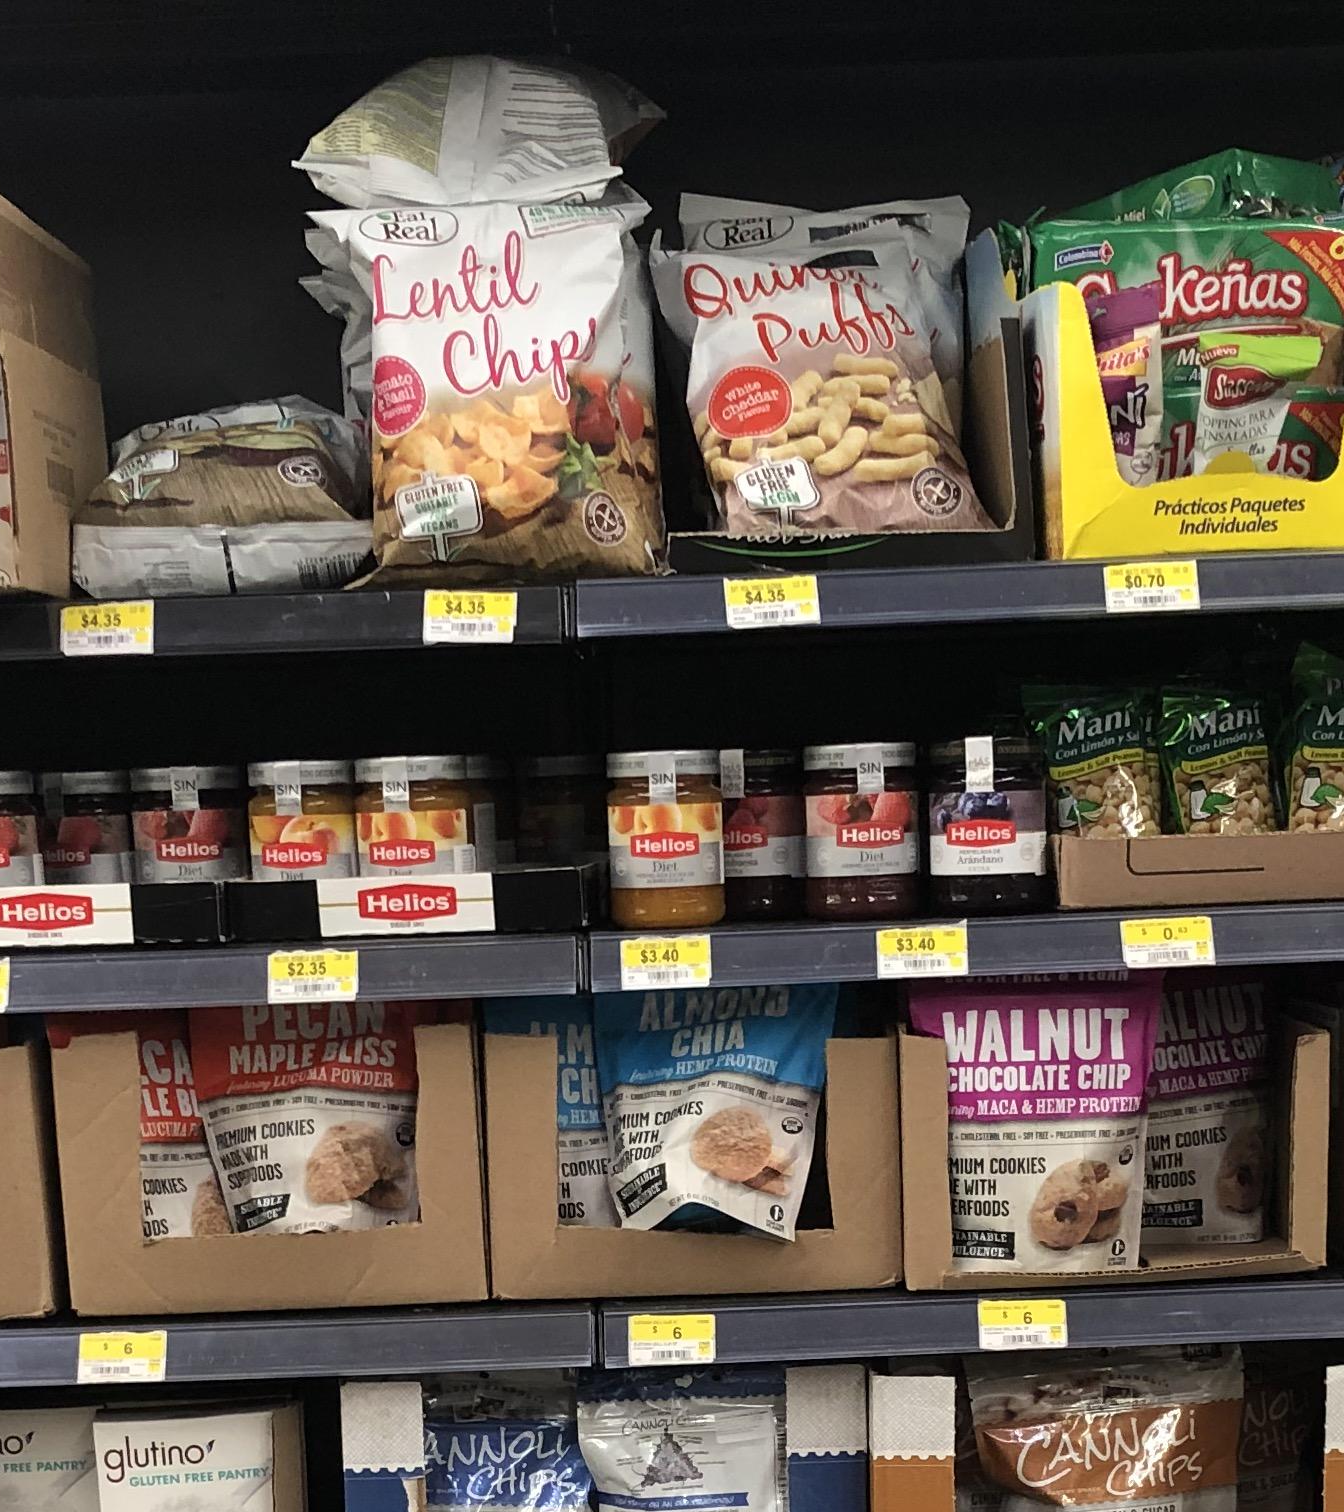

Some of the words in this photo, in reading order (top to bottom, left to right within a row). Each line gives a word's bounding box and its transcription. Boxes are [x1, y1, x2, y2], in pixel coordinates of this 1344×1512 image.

[382, 219, 439, 242] Real
[372, 230, 538, 326] Lentil
[753, 292, 915, 364] Puffs
[1154, 495, 1224, 515] Prácticos
[1228, 496, 1305, 516] Paquetes
[1179, 515, 1278, 535] Individuales
[1124, 574, 1165, 589] $0.70
[80, 612, 122, 629] $4.35
[1058, 708, 1130, 746] Maní
[950, 824, 1012, 841] Helios
[0, 902, 87, 925] Helios
[896, 936, 936, 952] $3.40
[668, 1019, 745, 1059] CHIA
[230, 1042, 314, 1075] MAPLE
[322, 1036, 396, 1067] BLISS
[674, 1054, 714, 1075] HEMP
[715, 1054, 778, 1076] PROTEIN
[331, 1068, 394, 1088] POWDER
[976, 1098, 1017, 1116] MACA
[1021, 1098, 1032, 1115] &
[1036, 1097, 1076, 1114] HEMP
